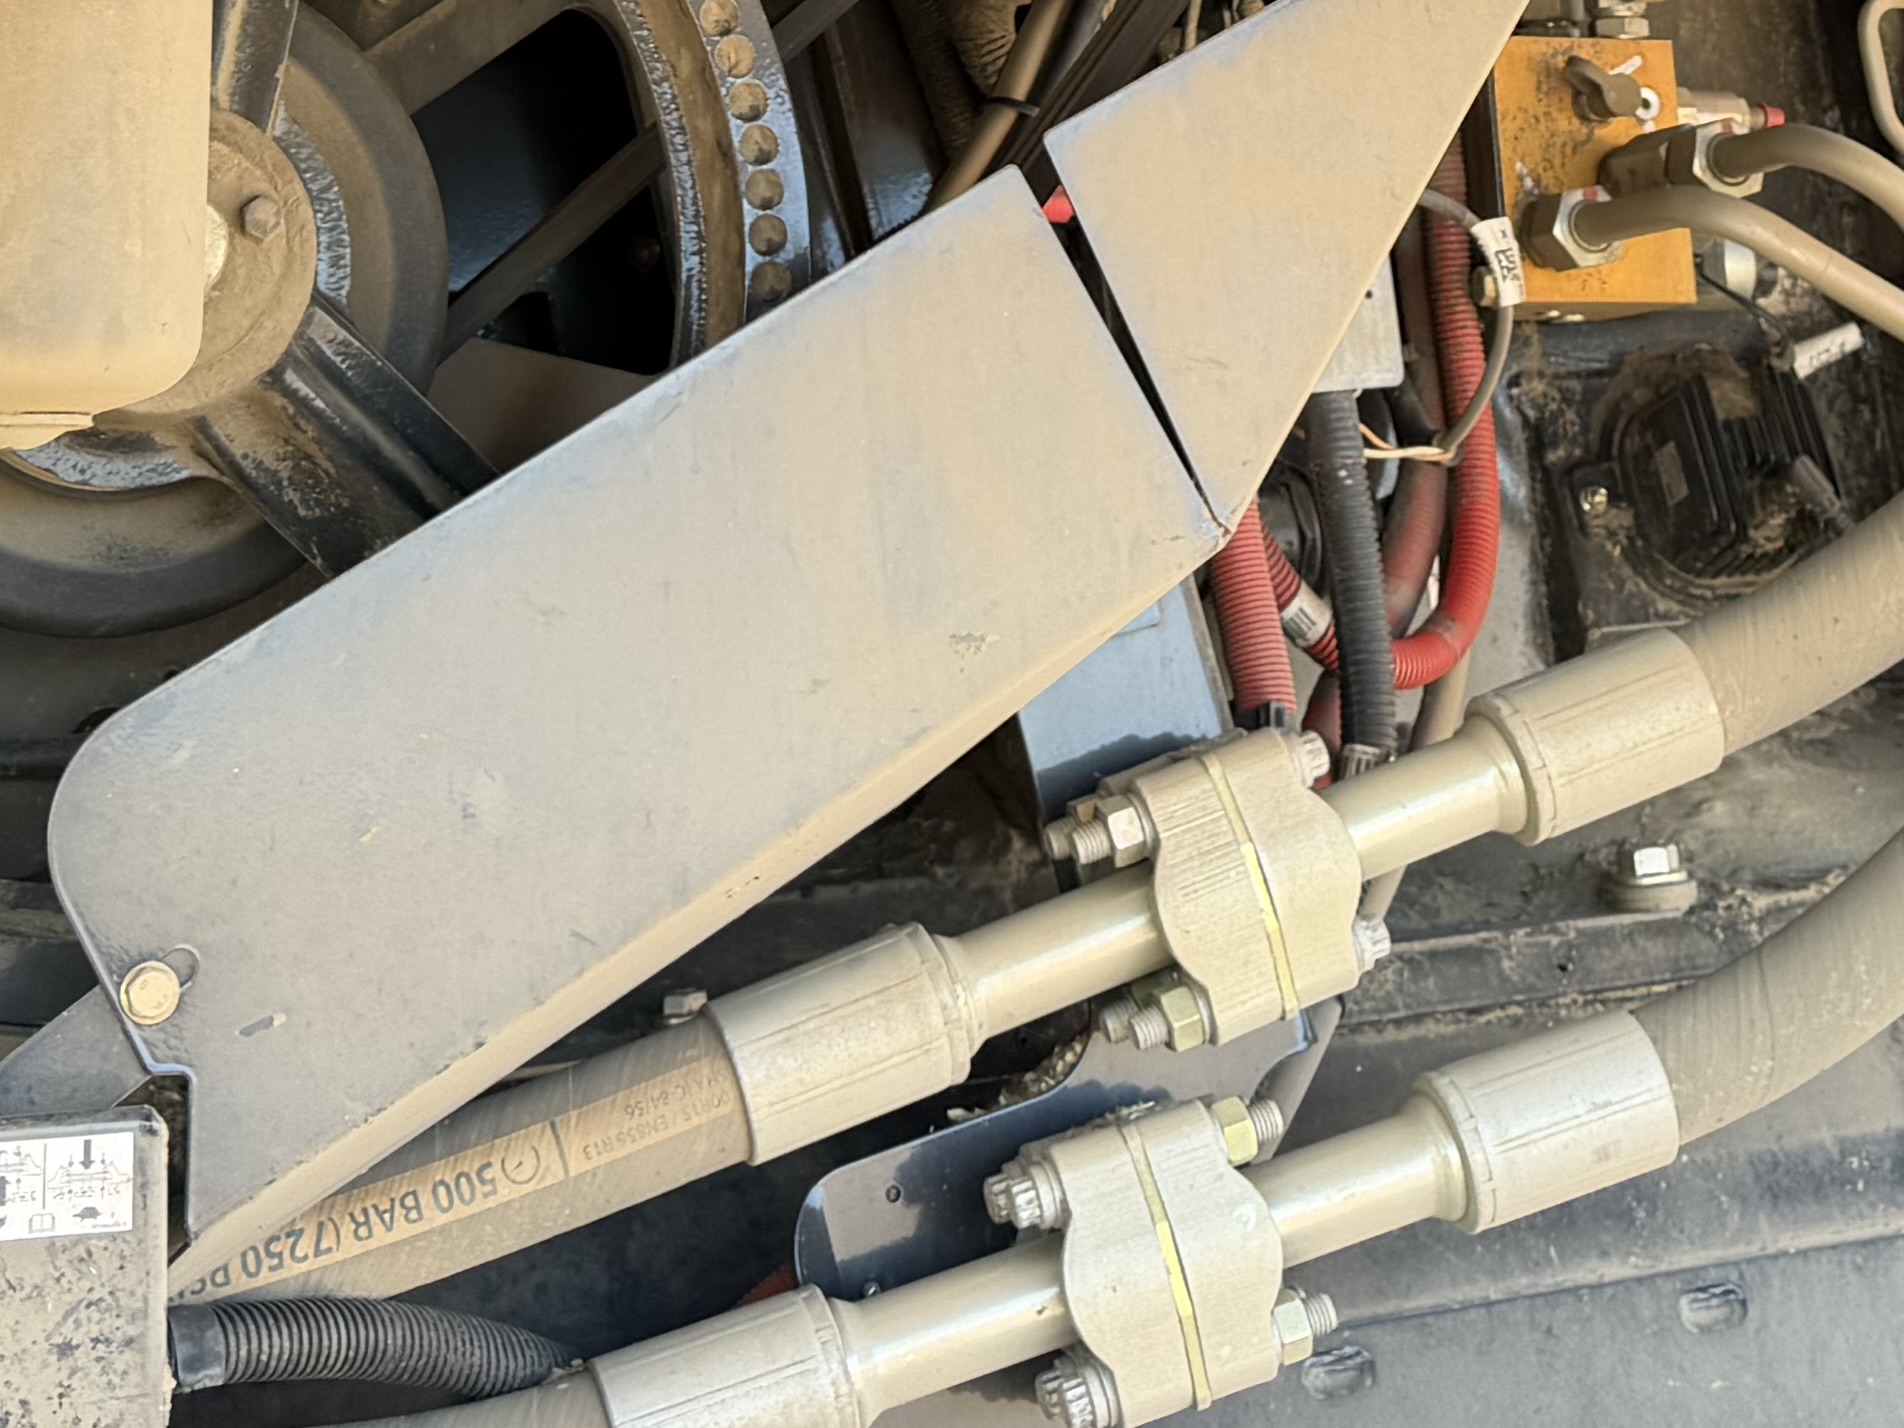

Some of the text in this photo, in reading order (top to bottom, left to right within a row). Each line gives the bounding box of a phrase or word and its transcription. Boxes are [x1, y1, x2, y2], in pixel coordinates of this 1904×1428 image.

[579, 1132, 613, 1159] R13
[428, 1162, 500, 1213] 500
[345, 1189, 425, 1241] BAR
[238, 1218, 343, 1277] (7250
